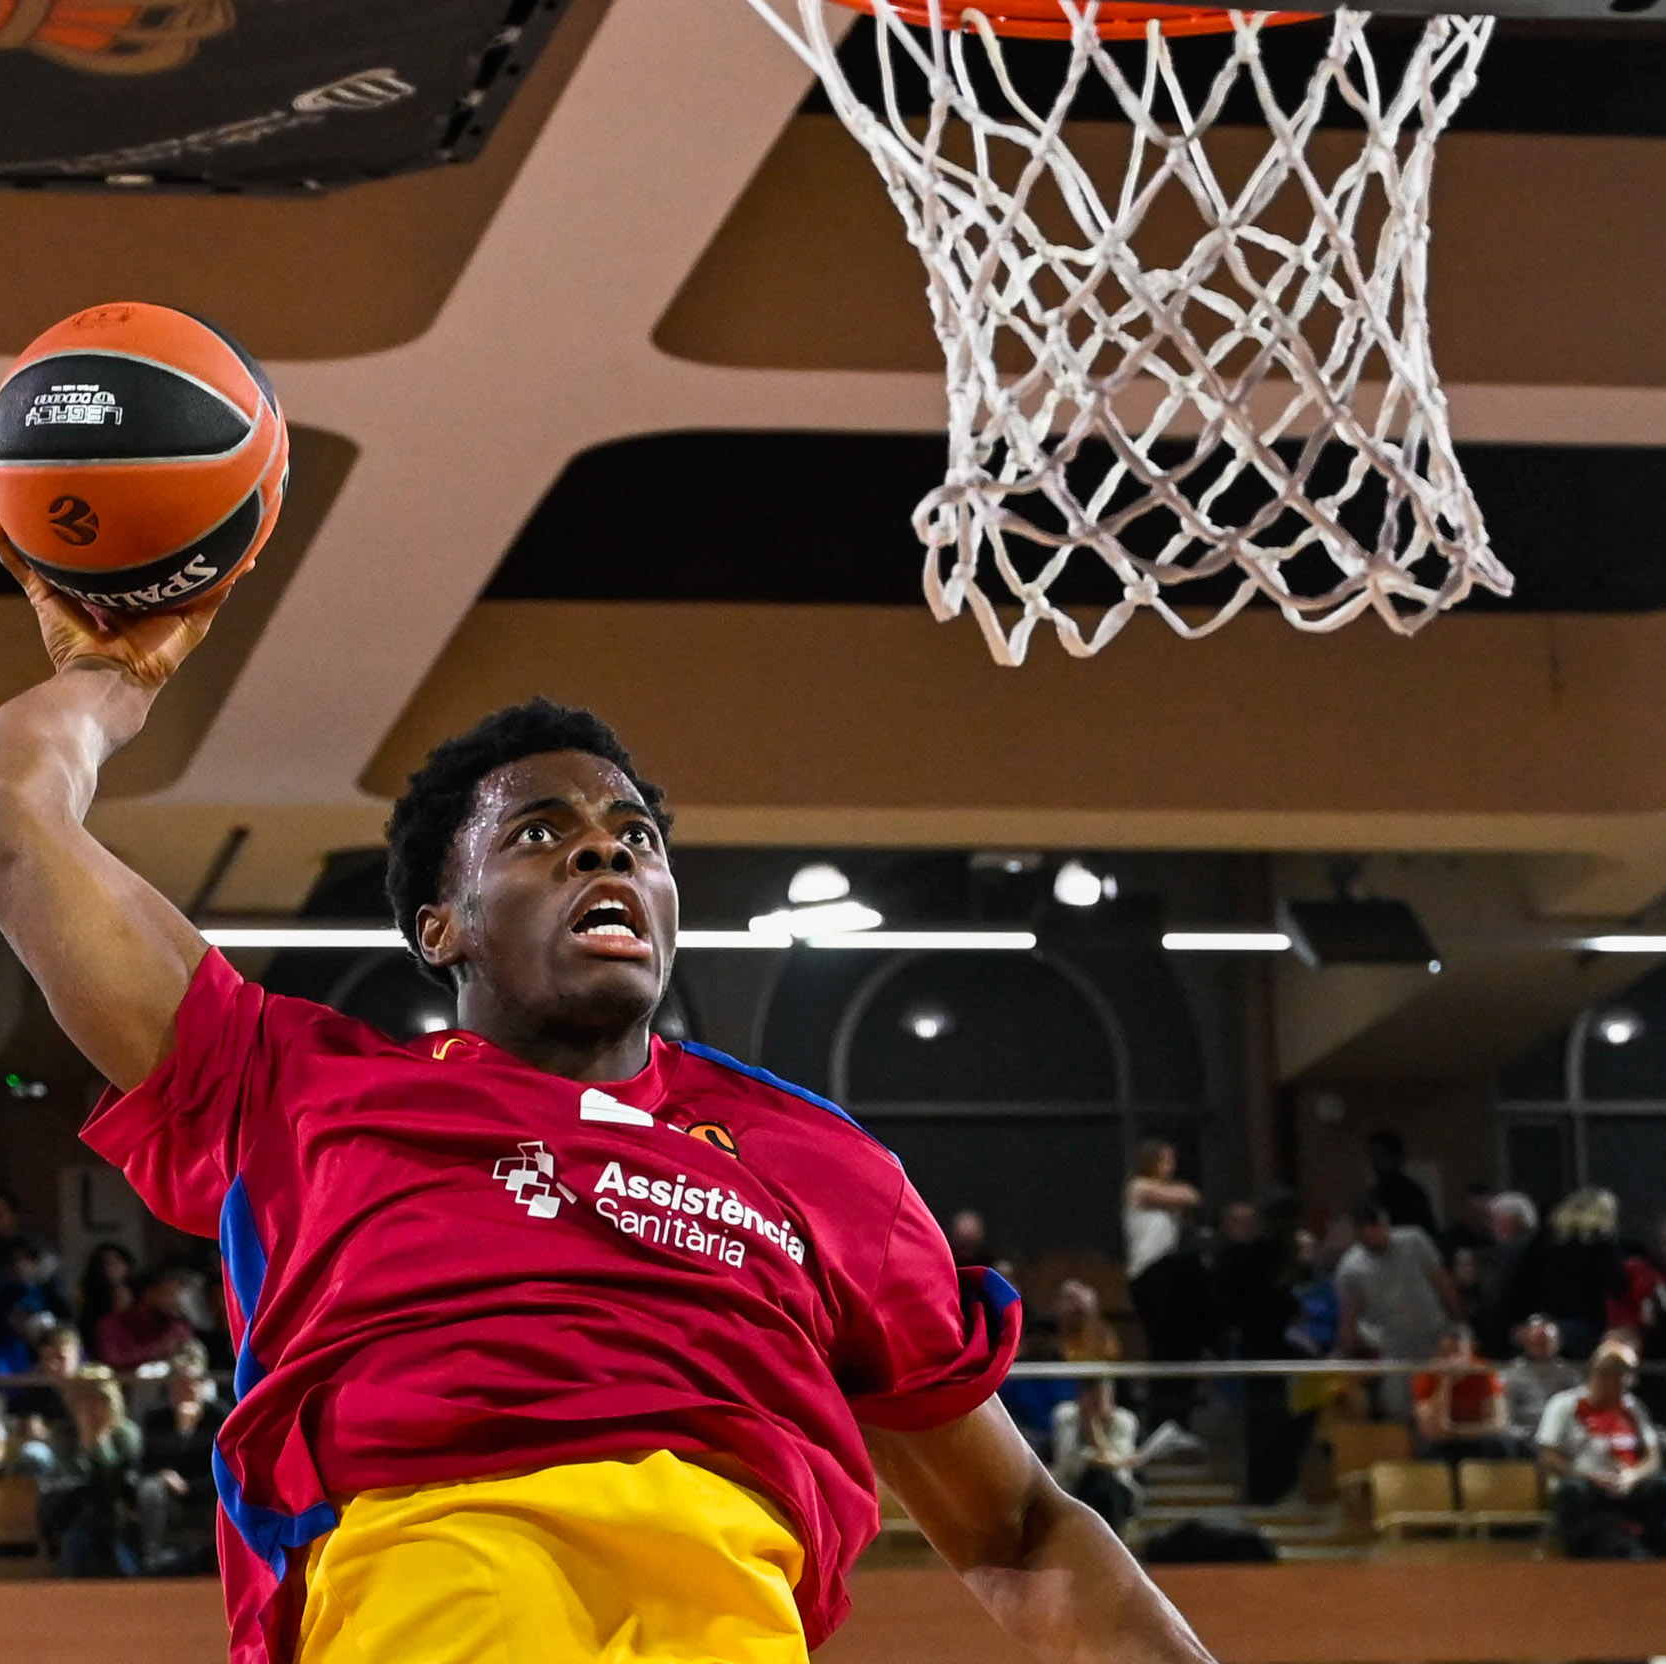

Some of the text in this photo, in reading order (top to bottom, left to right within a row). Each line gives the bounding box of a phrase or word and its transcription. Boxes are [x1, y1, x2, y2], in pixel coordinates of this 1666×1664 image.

[25, 405, 123, 427] LEGACY
[593, 1161, 806, 1266] Assistència
[595, 1199, 747, 1269] Sanitària
